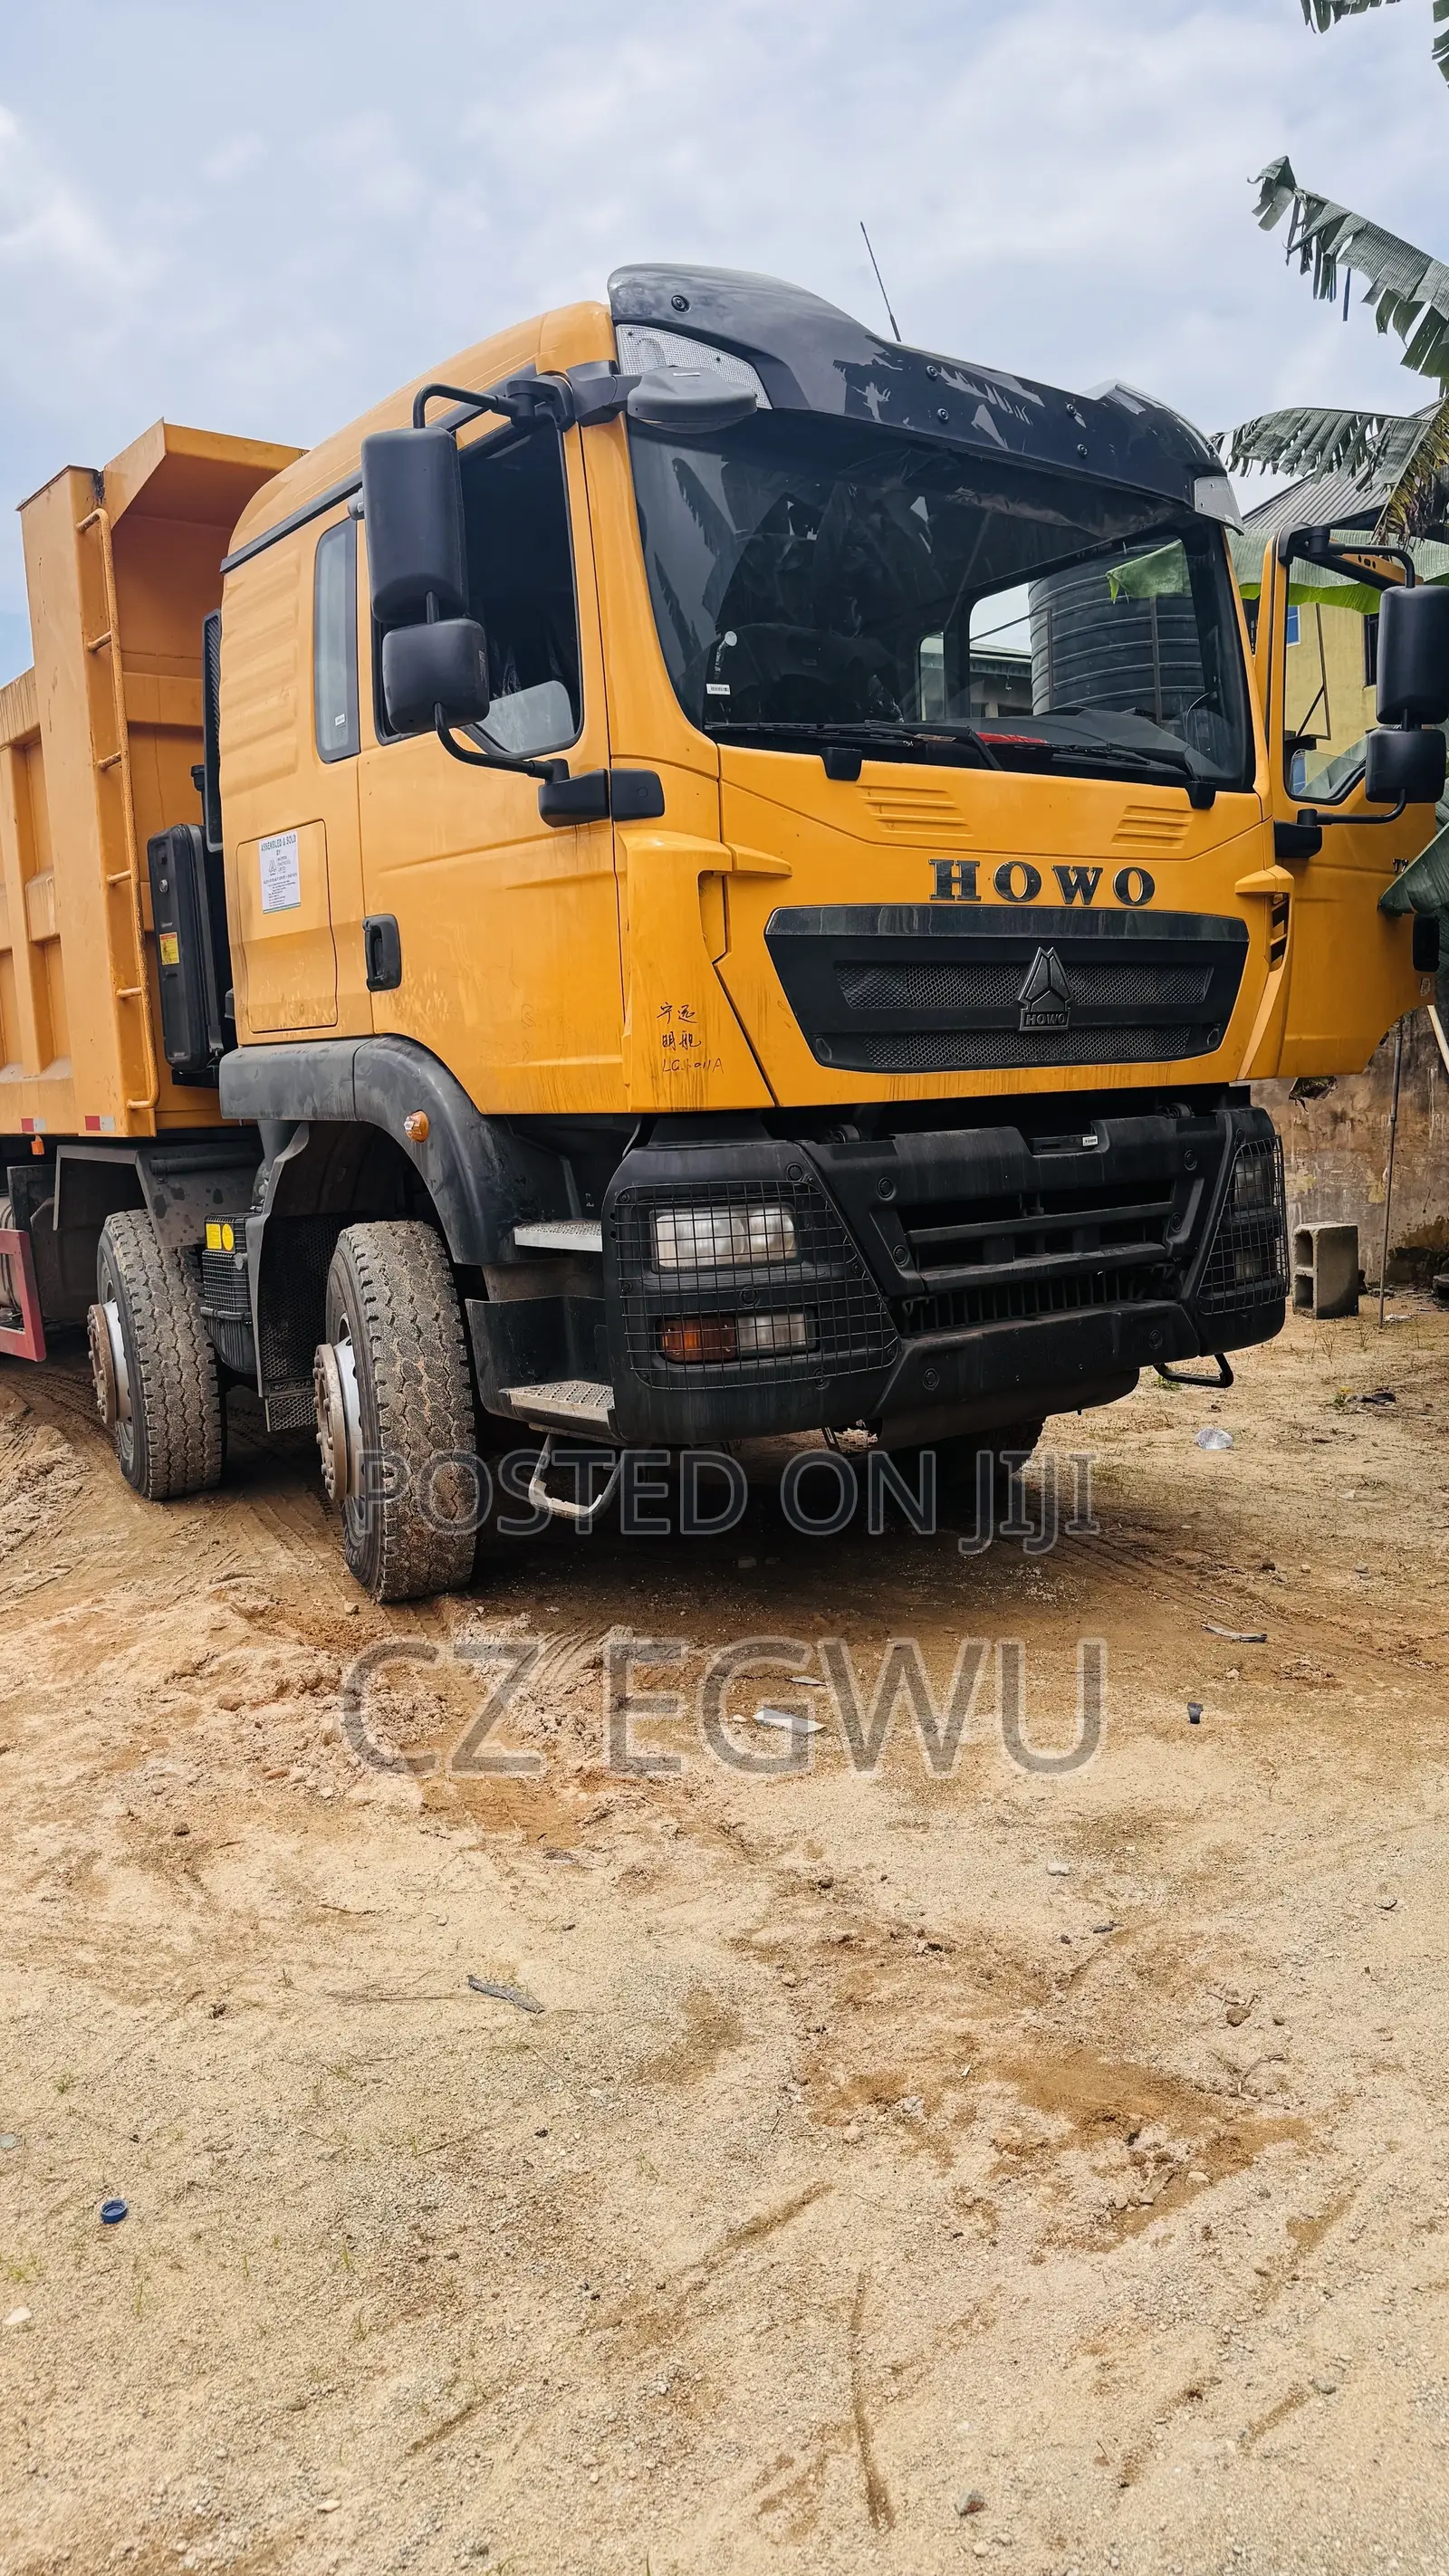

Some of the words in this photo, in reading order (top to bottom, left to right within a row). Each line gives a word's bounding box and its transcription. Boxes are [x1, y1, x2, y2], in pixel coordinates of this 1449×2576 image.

[261, 838, 282, 851] ASSEMBLED
[286, 834, 297, 845] SOLD
[928, 859, 1155, 905] HOWO
[1025, 1013, 1066, 1025] HOWO
